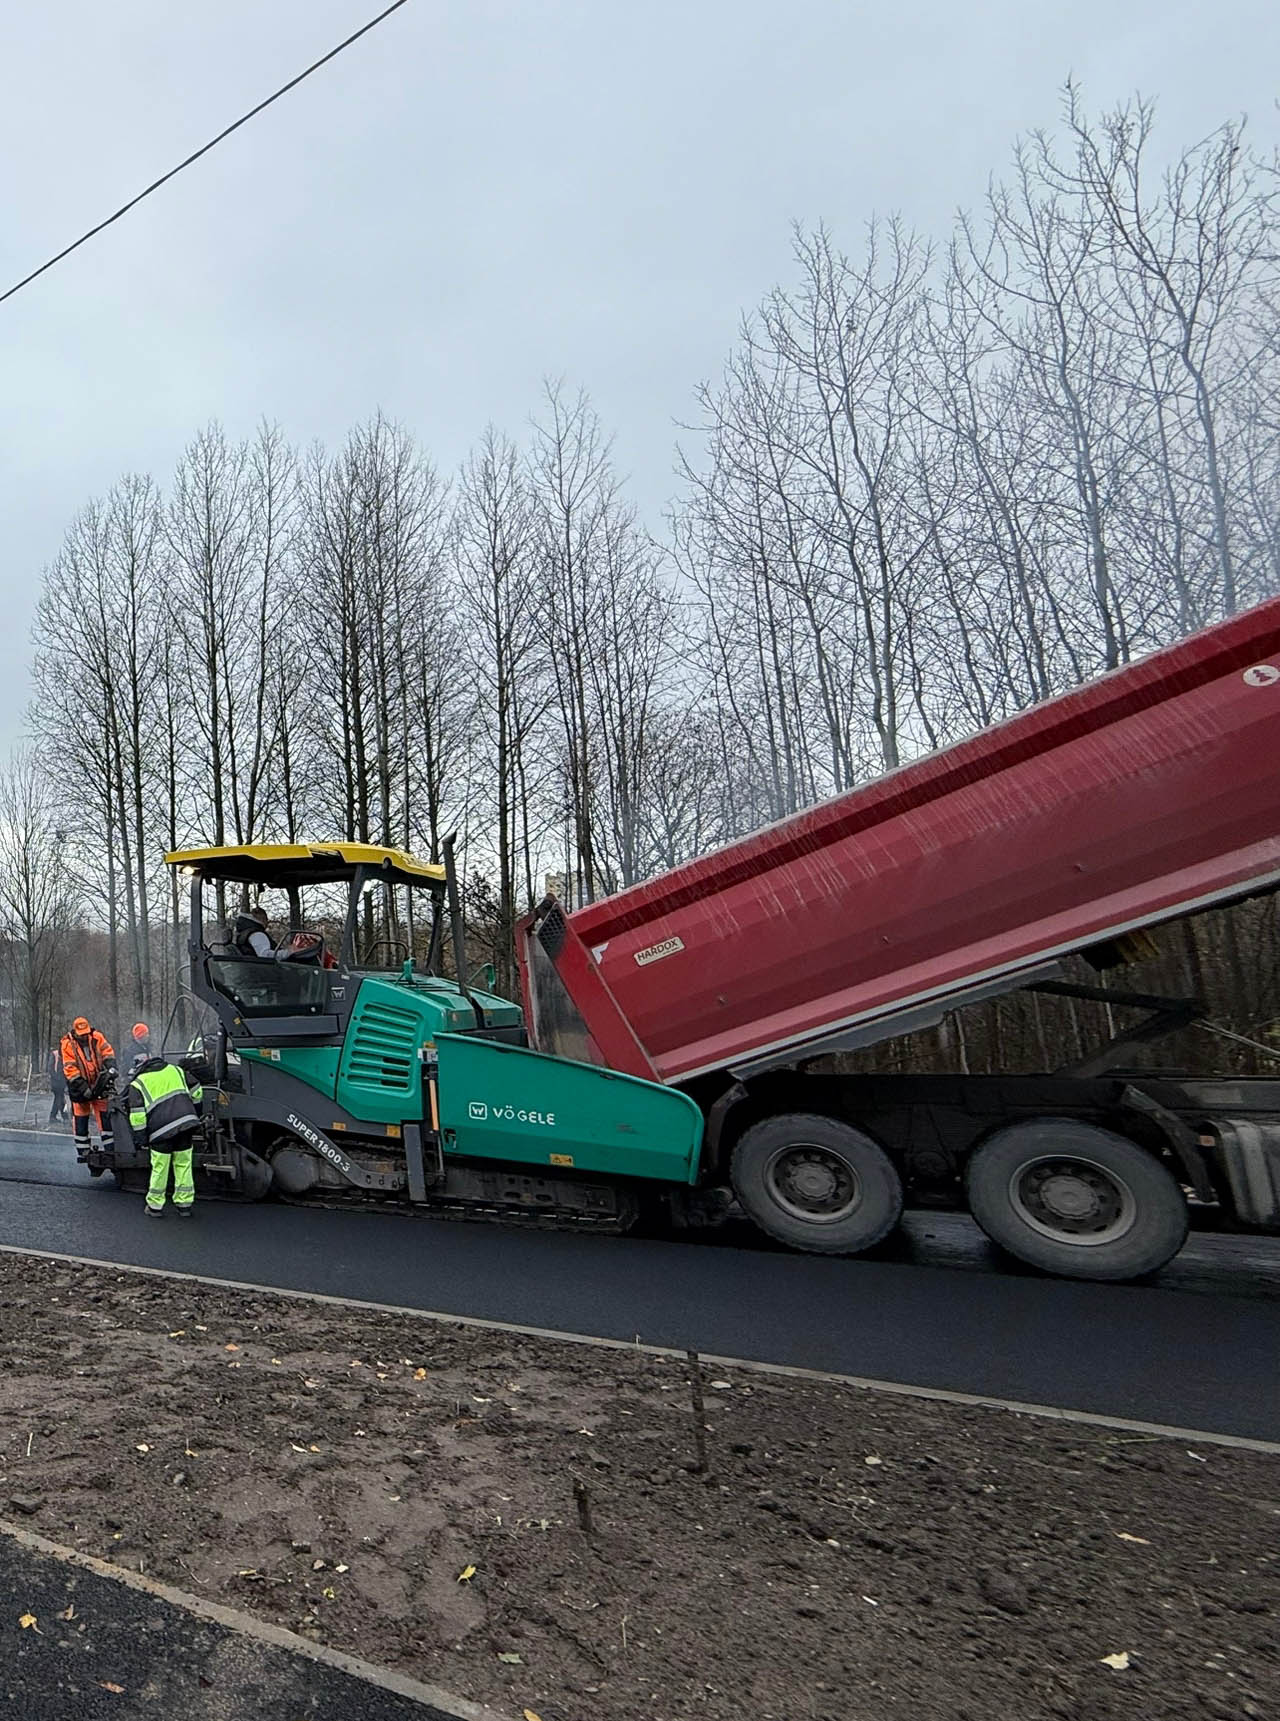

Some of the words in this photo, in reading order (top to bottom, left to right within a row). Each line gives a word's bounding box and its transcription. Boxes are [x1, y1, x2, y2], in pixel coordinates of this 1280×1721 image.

[637, 938, 678, 961] HARDOX
[492, 1104, 555, 1126] VÖGELE
[286, 1113, 319, 1144] SUPER
[317, 1139, 351, 1172] 1800-3
